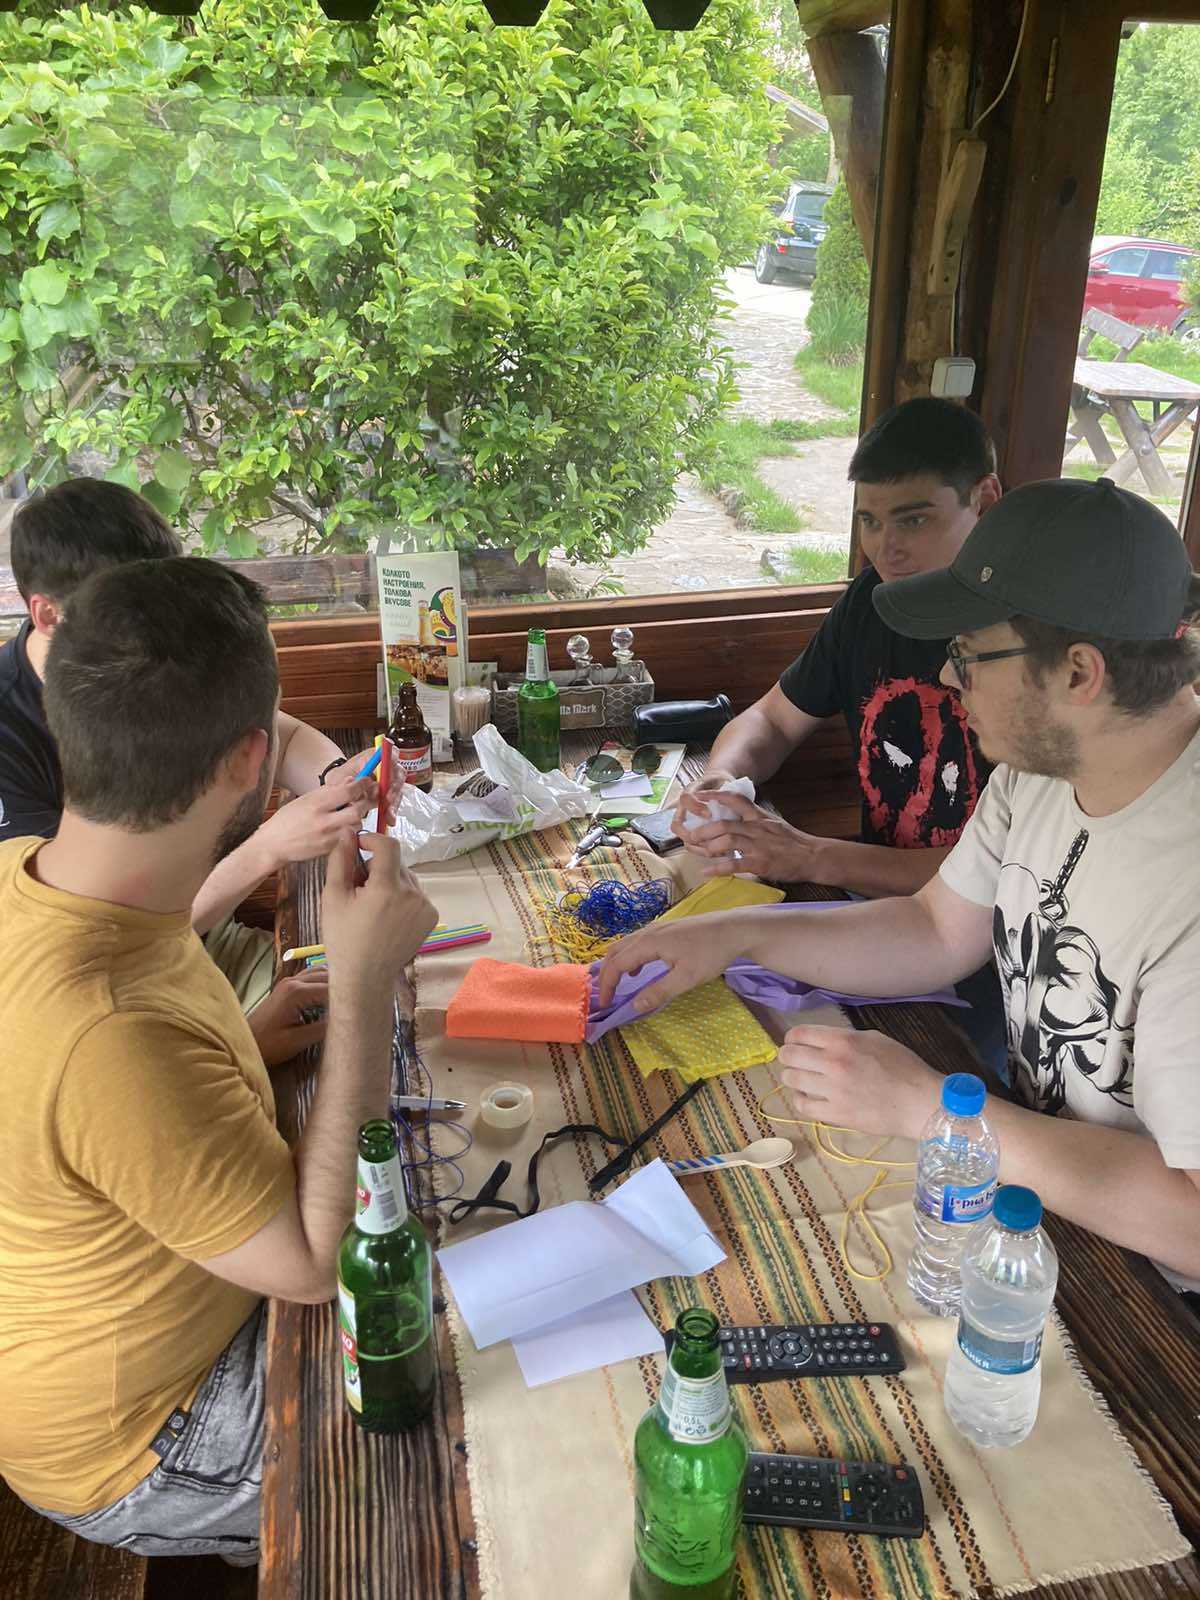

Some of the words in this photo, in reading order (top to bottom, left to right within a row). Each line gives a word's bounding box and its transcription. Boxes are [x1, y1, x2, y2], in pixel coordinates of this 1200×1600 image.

[382, 568, 411, 579] КОЛКОТО
[384, 587, 412, 598] ТОЛКОВА
[384, 597, 411, 607] ВКУСОВЕ
